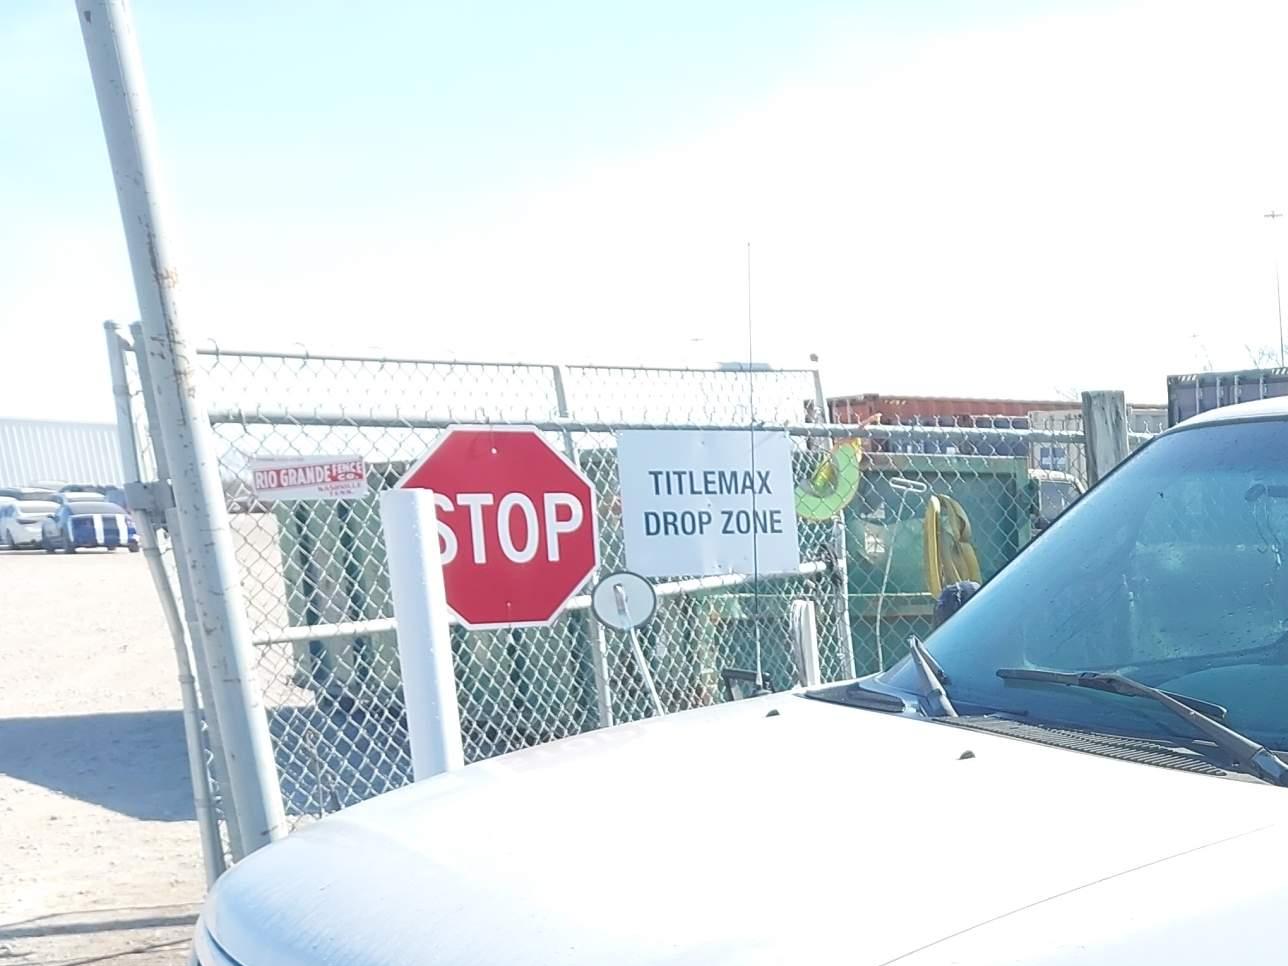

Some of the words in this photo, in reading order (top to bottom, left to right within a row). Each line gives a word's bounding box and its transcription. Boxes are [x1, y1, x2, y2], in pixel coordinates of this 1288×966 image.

[255, 470, 278, 489] RIO
[279, 465, 331, 487] GRANDE
[331, 462, 362, 477] FENCE
[648, 470, 772, 496] TITLEMAX
[644, 510, 712, 536] DROP
[721, 509, 783, 534] ZONE
